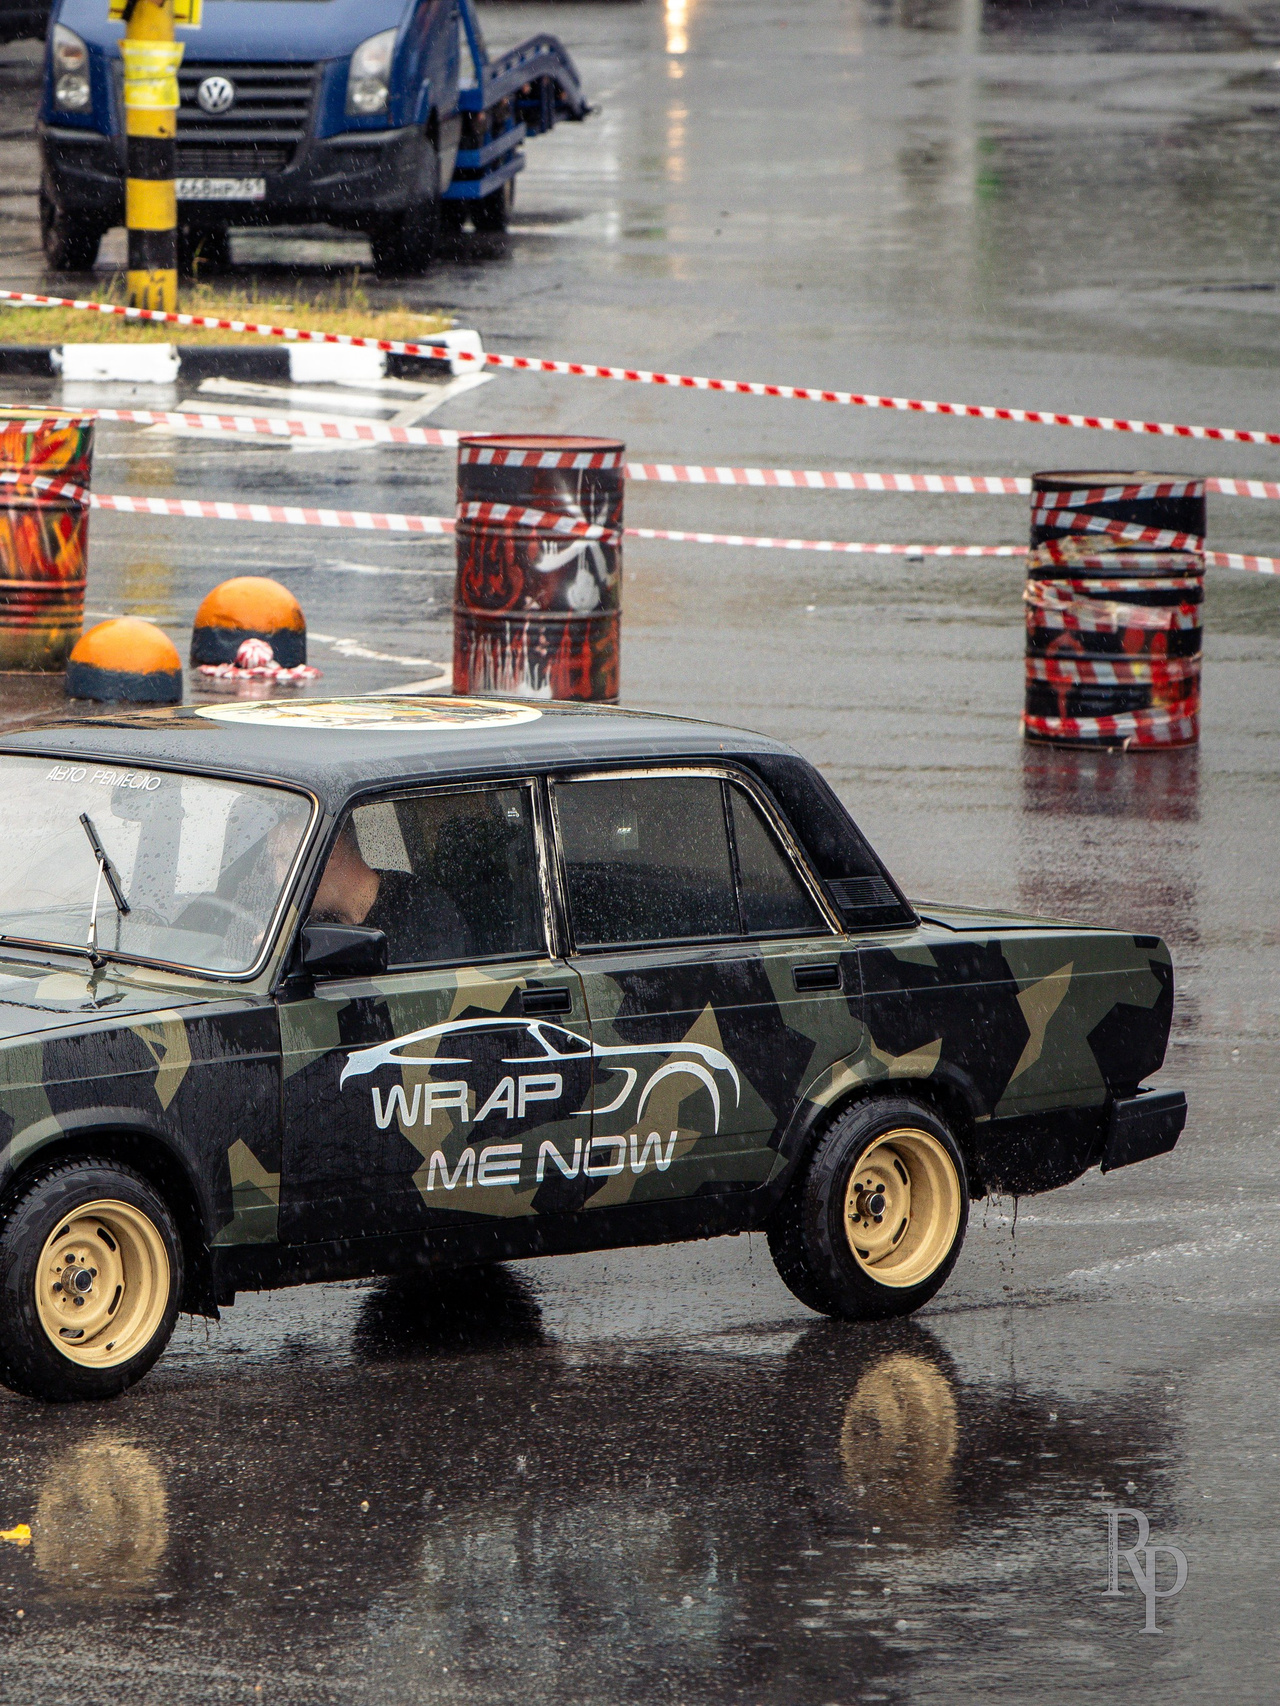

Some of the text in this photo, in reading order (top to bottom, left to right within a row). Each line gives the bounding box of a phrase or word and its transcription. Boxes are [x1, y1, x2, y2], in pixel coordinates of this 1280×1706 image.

[46, 765, 162, 791] АВТО РЕМЕСЛО
[371, 1073, 564, 1130] WRAP
[426, 1130, 678, 1192] ME NOW
